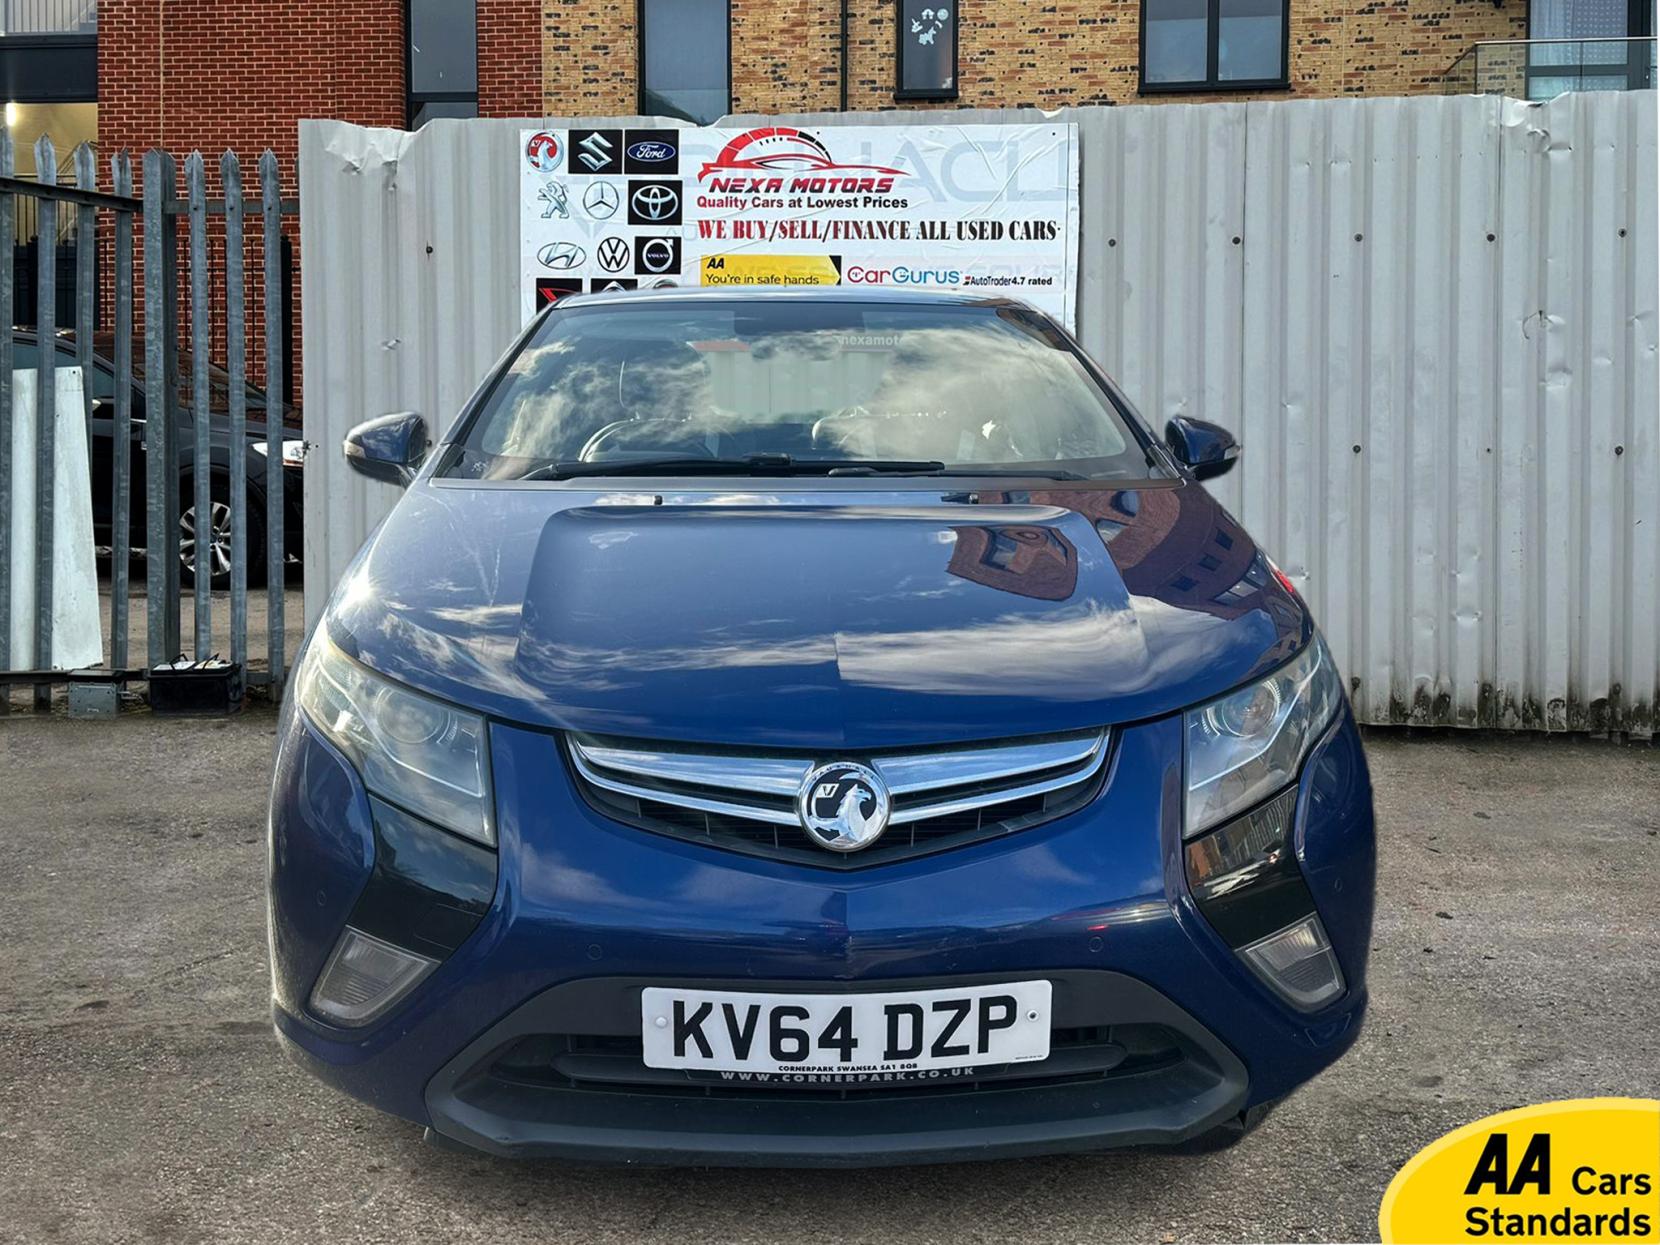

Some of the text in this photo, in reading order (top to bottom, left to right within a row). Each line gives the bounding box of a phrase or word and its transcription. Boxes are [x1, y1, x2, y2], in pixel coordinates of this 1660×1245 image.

[636, 144, 666, 158] Ford
[709, 178, 894, 194] NEXA MOTORS
[697, 196, 908, 210] Quality Cars at Lowest Prices
[698, 220, 727, 240] WE
[916, 220, 950, 241] ALL
[957, 220, 1004, 240] USED
[1009, 220, 1057, 241] CARS
[707, 257, 725, 269] AA
[706, 273, 819, 286] You're in safe hands
[847, 266, 960, 284] CarGurus
[970, 276, 1053, 286] AutoTrader 4.7 rated
[673, 995, 1018, 1062] KV64 DZP
[720, 1067, 974, 1083] WWW.CORNERPARK.CO.UK
[778, 1065, 834, 1073] CORNERPARK
[837, 1064, 878, 1072] SWANSEA
